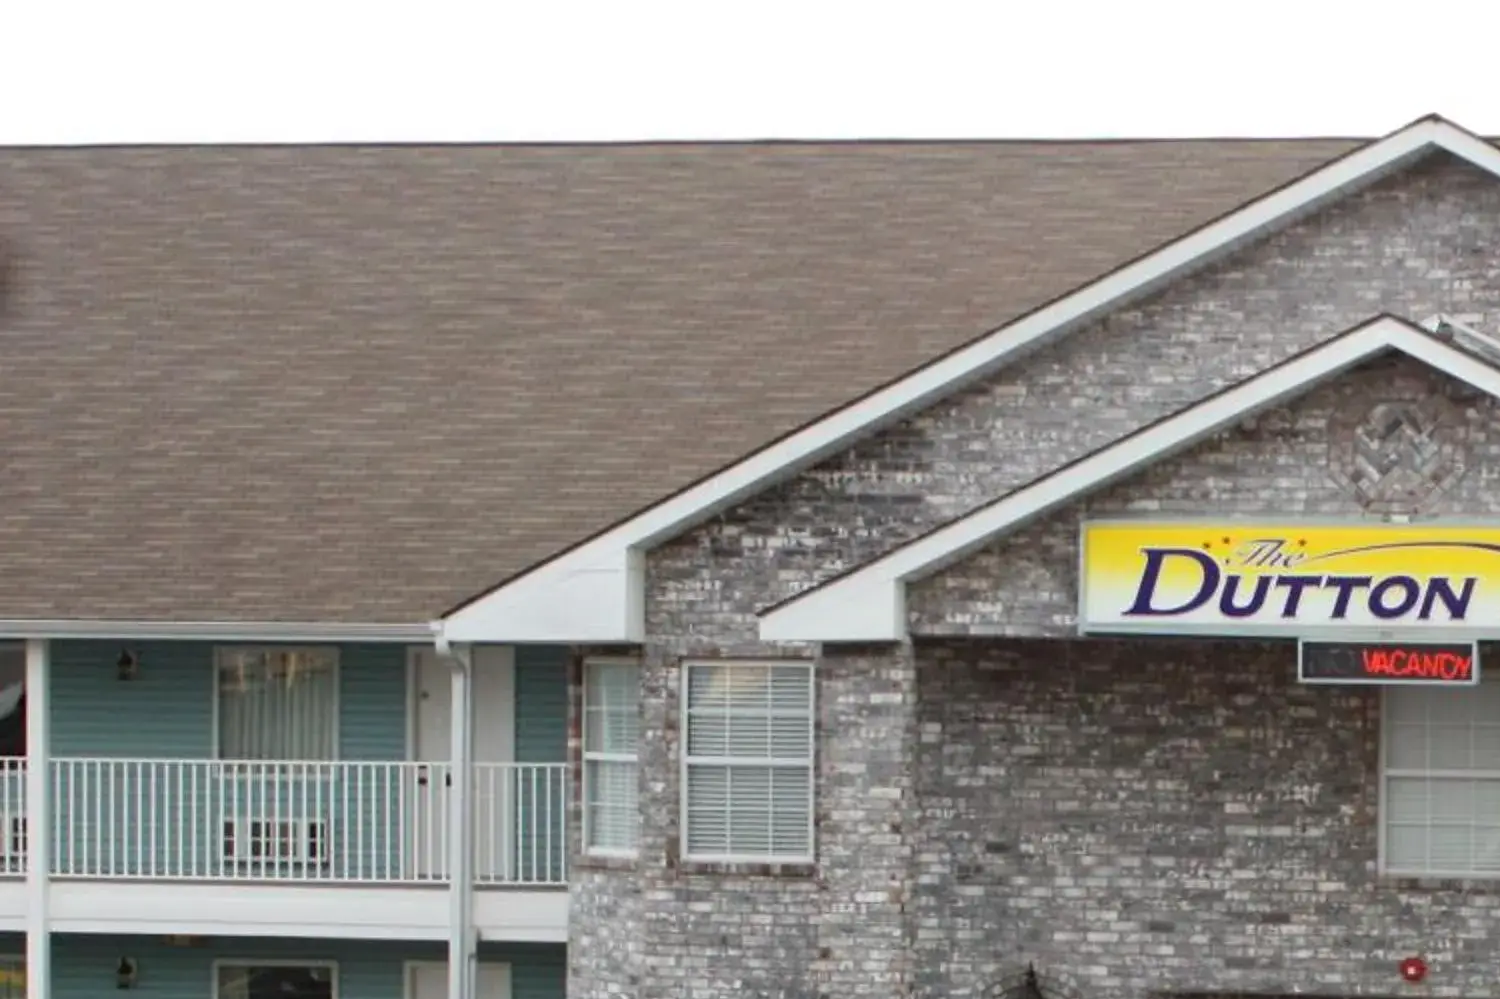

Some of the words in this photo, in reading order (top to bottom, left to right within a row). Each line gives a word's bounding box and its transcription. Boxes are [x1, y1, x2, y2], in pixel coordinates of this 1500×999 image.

[1240, 538, 1305, 567] The
[1121, 548, 1477, 619] DUTTON
[1363, 648, 1472, 680] VACANCY
